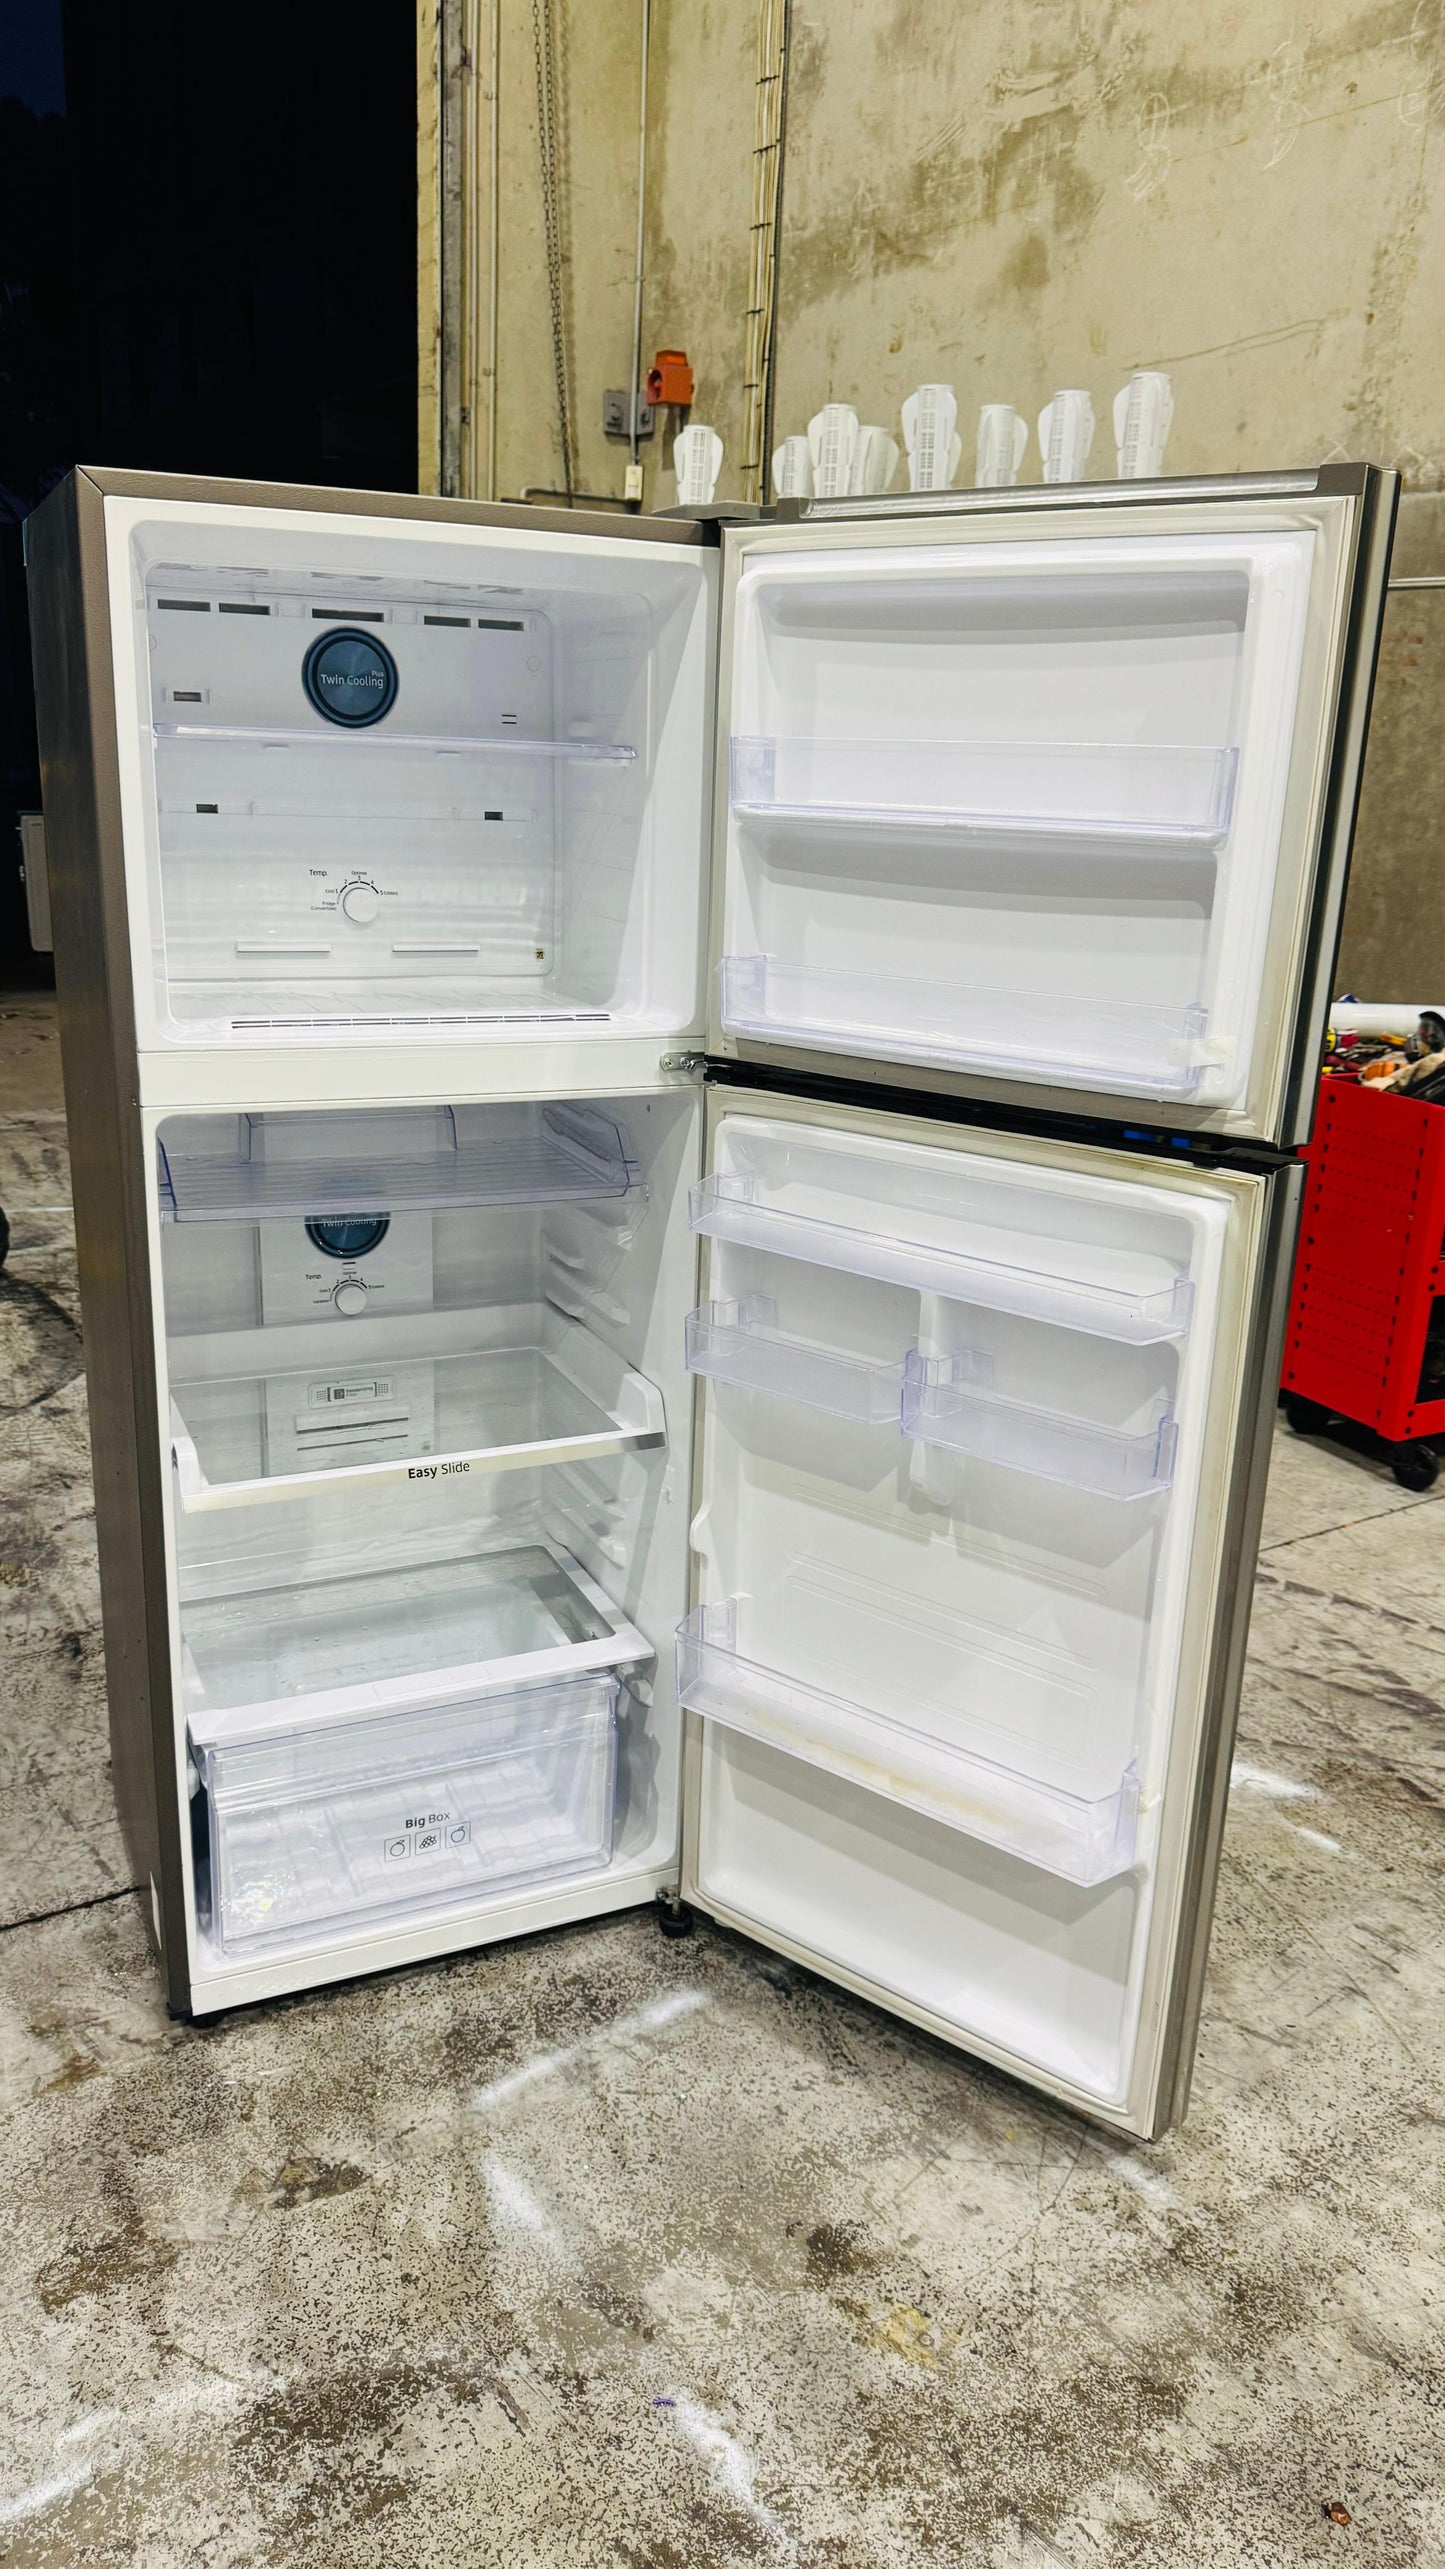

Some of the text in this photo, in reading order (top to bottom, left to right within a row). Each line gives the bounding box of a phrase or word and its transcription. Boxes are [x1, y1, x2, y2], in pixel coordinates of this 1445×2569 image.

[320, 674, 384, 689] Twin Cooling
[309, 869, 328, 877] Temp.
[408, 1461, 470, 1479] Easy Slide
[405, 1812, 450, 1829] Big Box
